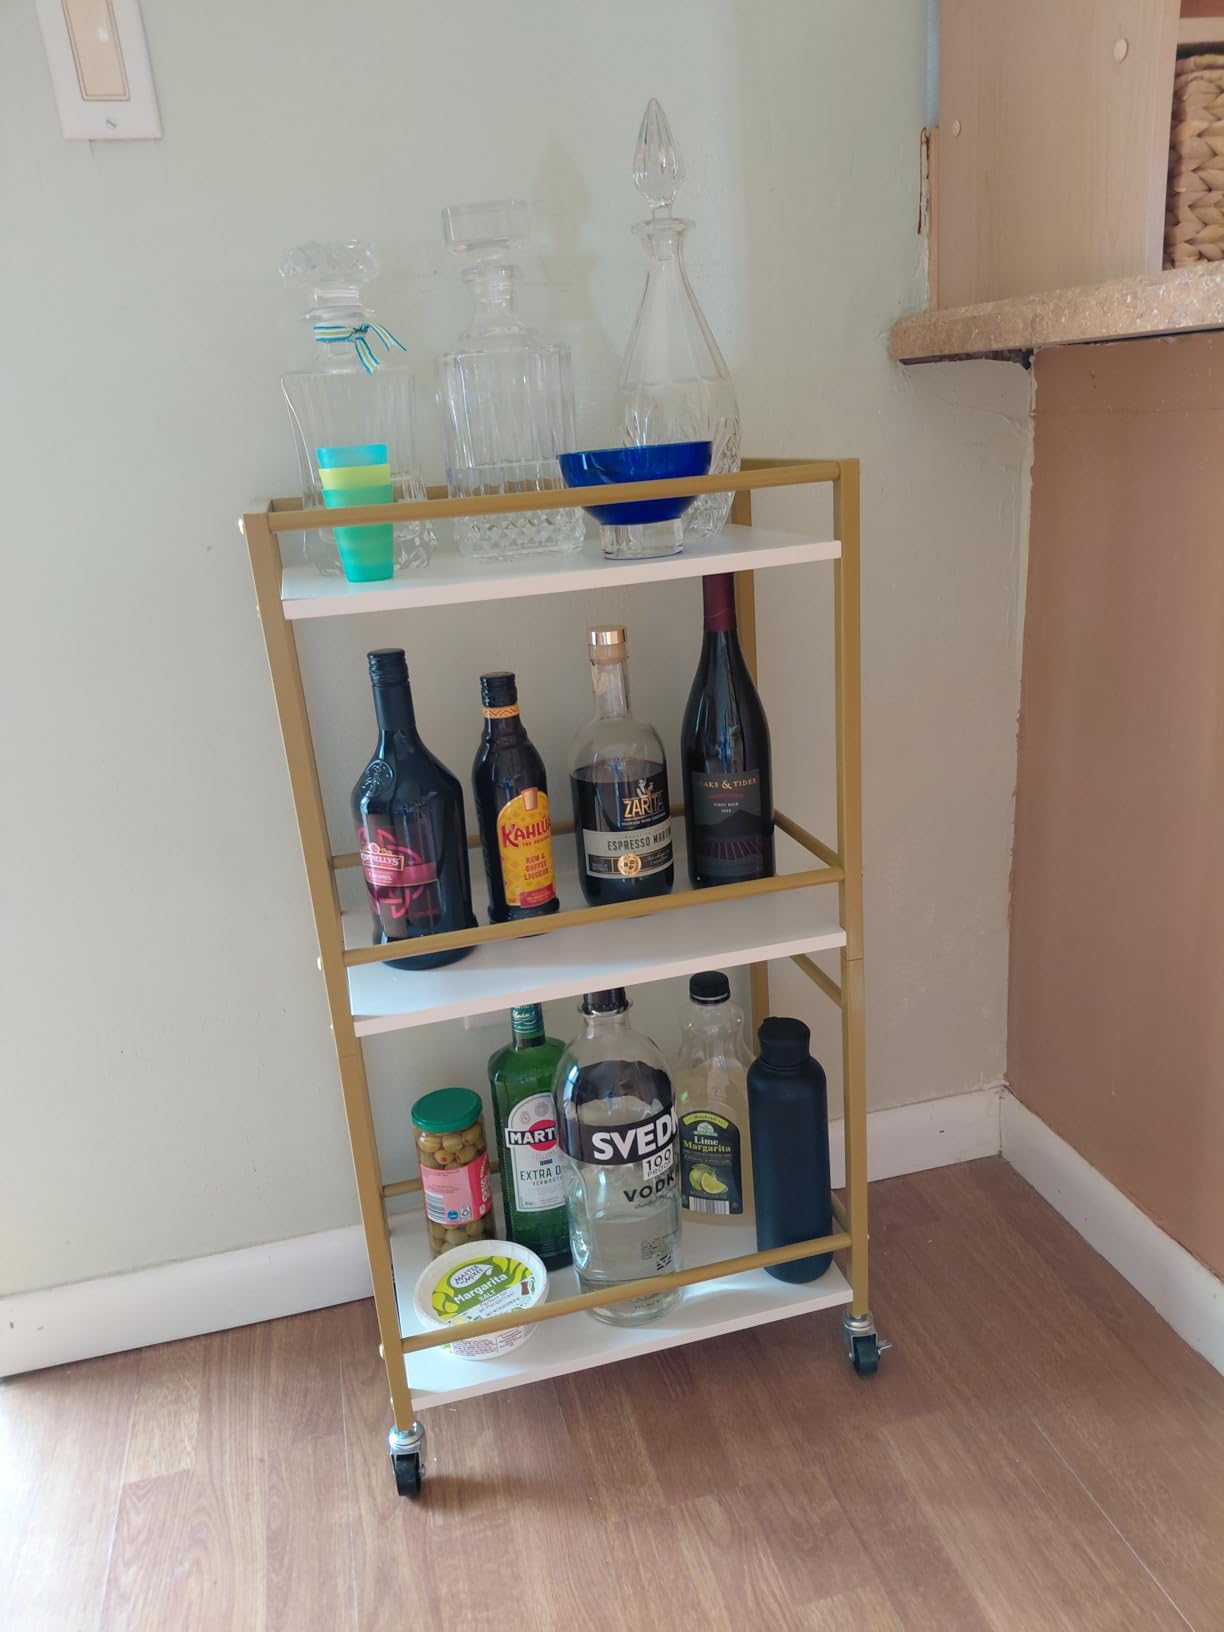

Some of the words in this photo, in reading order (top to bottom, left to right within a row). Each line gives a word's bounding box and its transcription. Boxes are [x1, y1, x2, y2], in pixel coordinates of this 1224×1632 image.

[721, 779, 732, 790] &
[733, 777, 757, 788] TIDES
[607, 836, 651, 851] ESPRESSO
[525, 861, 547, 872] COFFEE
[526, 855, 540, 864] RUM
[524, 867, 549, 881] LIQUEUR
[509, 1126, 556, 1146] MART
[592, 1106, 678, 1161] SVED
[694, 1135, 719, 1146] Lime
[683, 1139, 731, 1153] Margarita
[646, 1148, 671, 1172] 100
[520, 1168, 552, 1181] EXTRA
[623, 1170, 675, 1203] VODK
[454, 1264, 479, 1285] MASTER
[453, 1273, 508, 1305] Margarita
[478, 1290, 496, 1302] SALT
